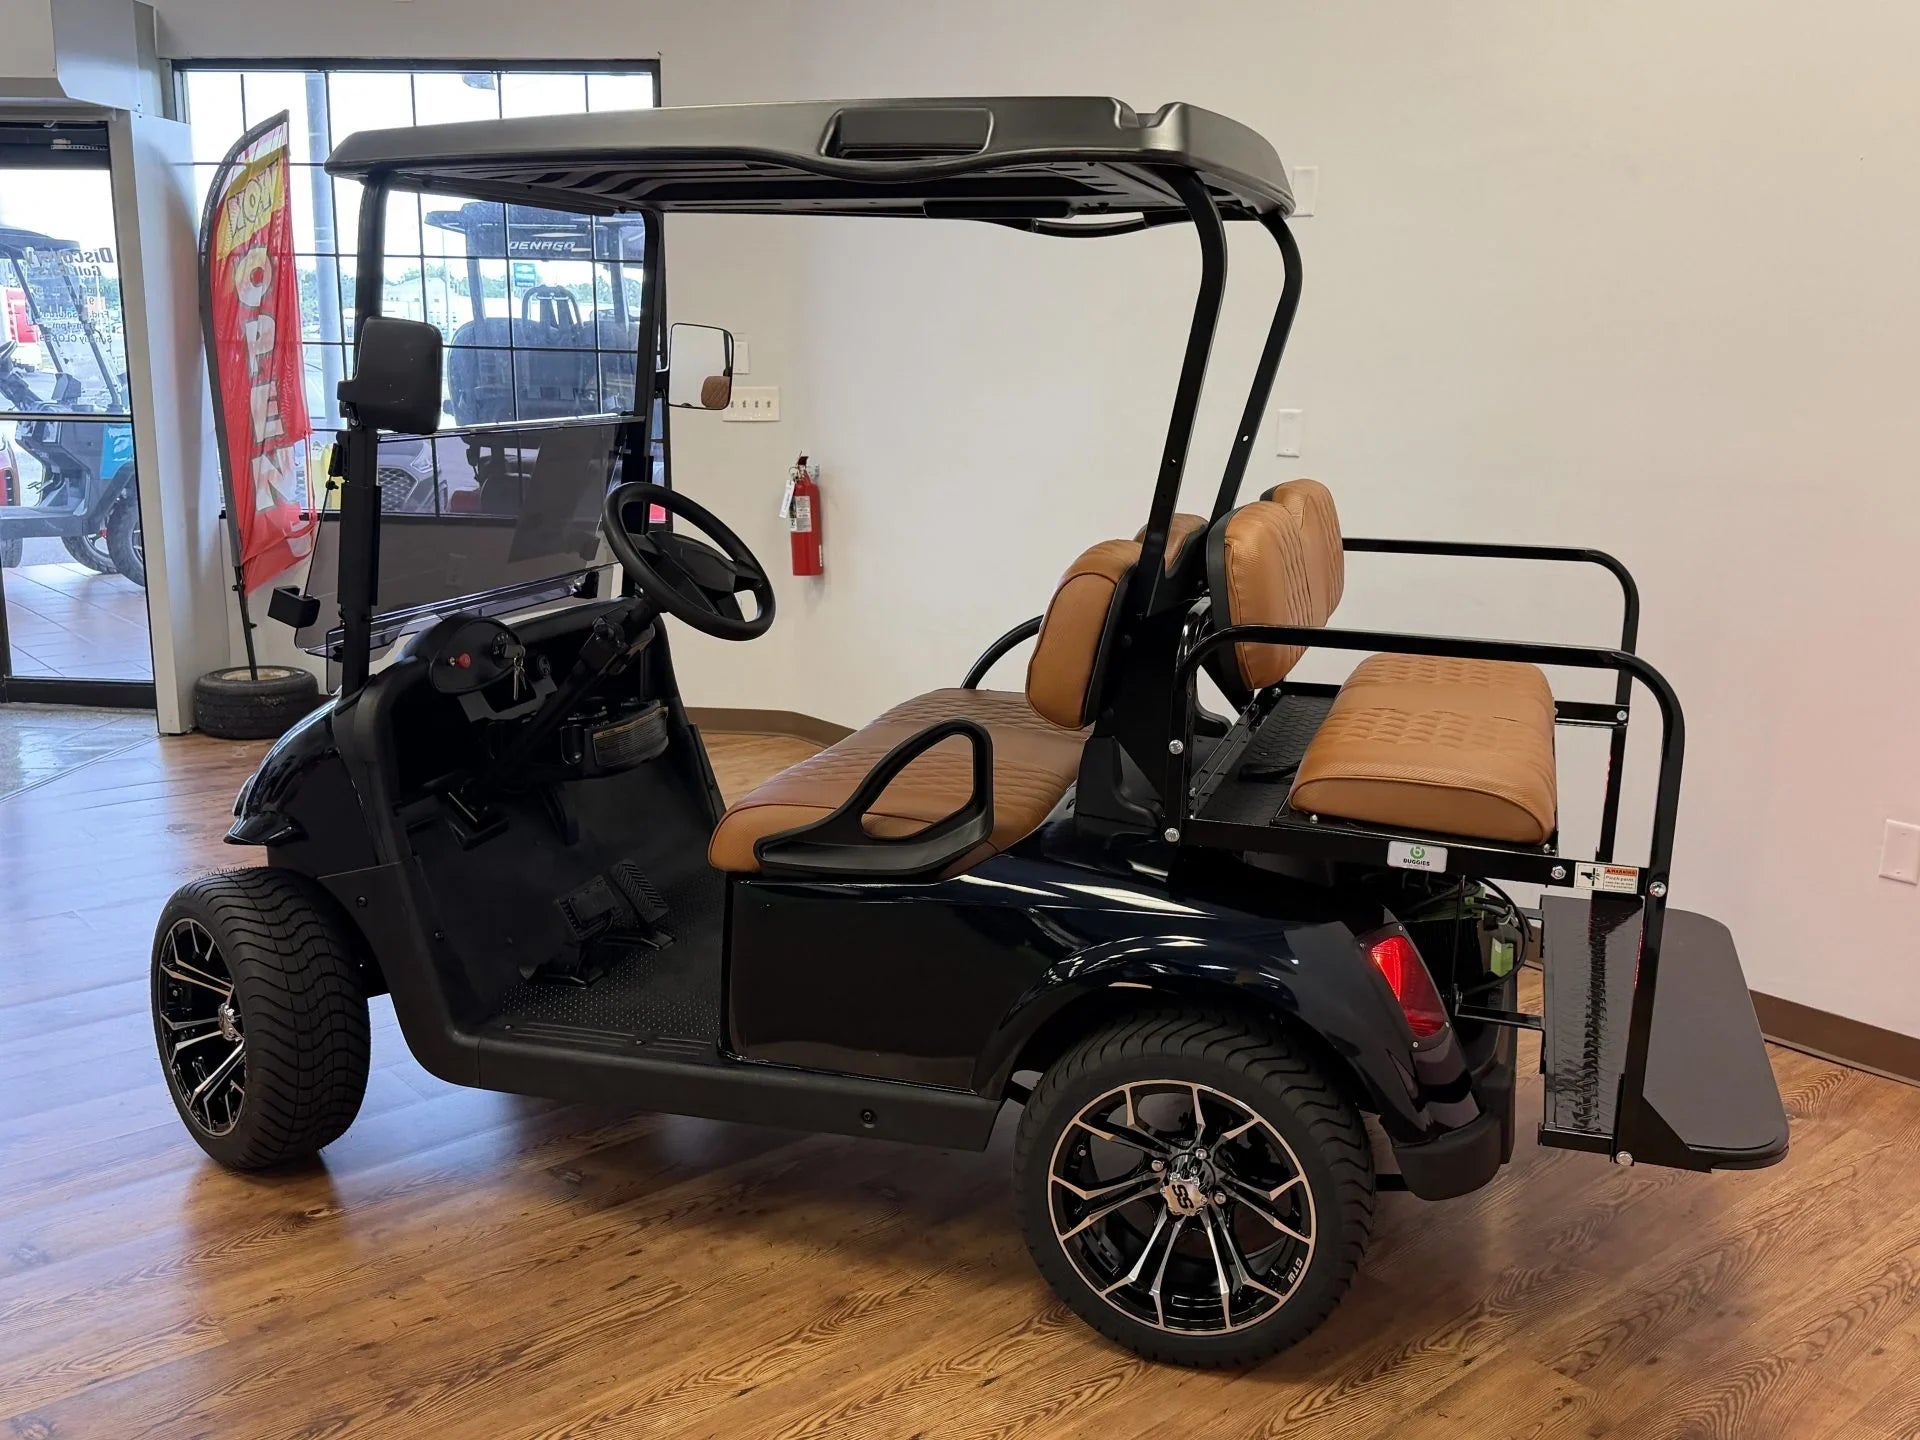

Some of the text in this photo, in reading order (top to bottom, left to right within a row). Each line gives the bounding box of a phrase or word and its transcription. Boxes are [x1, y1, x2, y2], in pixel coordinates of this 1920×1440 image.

[227, 157, 280, 239] NOW
[509, 241, 576, 251] DENAGO
[233, 246, 312, 557] OPEN
[1403, 858, 1430, 866] BUGGIES
[1287, 1257, 1303, 1284] GTW
